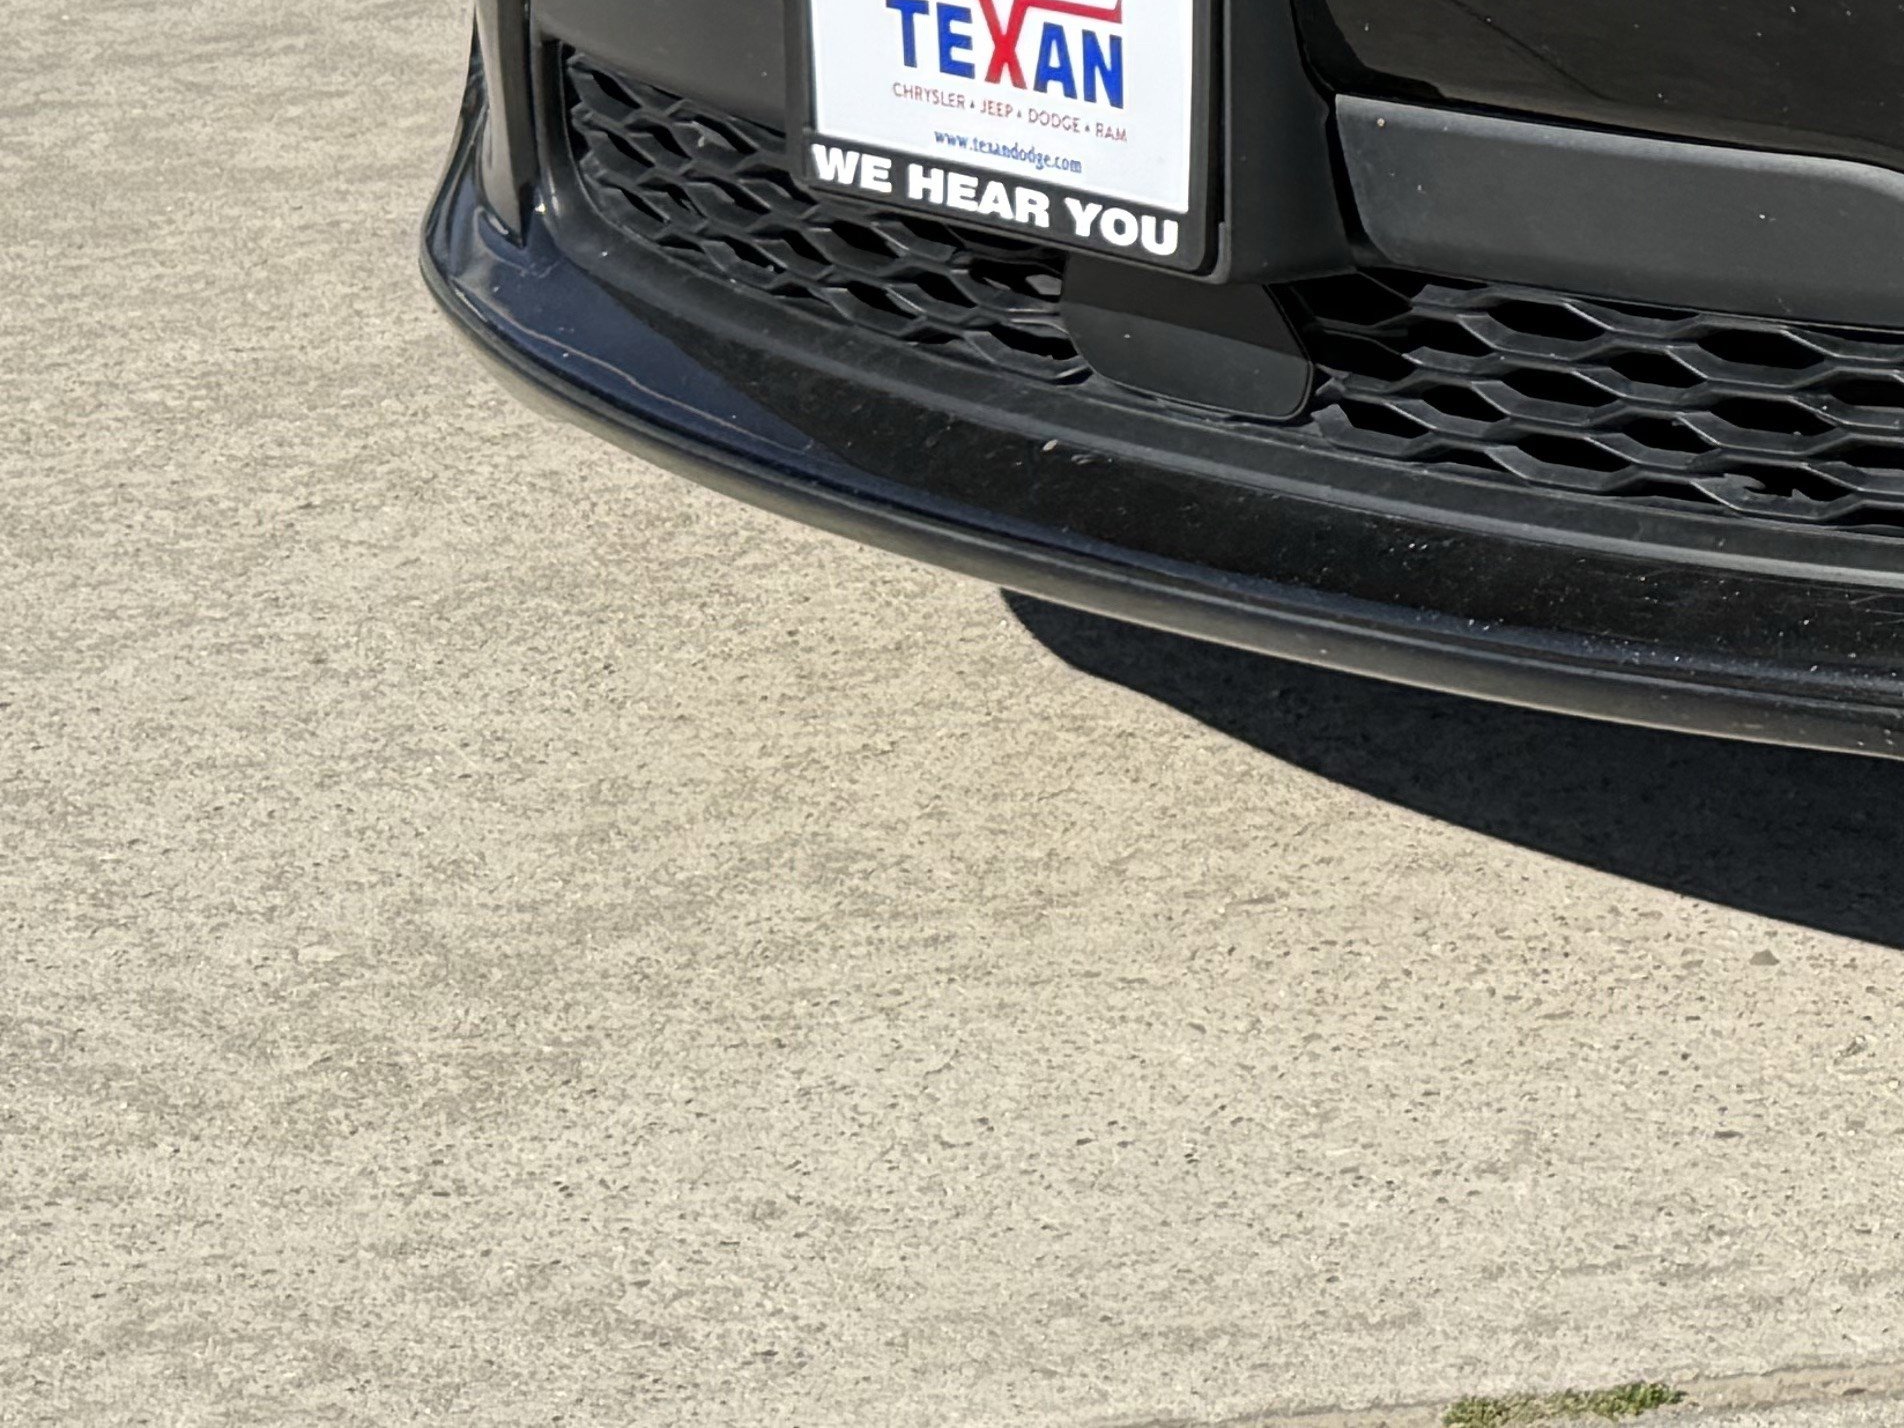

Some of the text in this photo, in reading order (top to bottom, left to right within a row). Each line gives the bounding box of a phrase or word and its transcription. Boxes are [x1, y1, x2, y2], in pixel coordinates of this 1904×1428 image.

[892, 81, 1128, 143] CHRYSLER JEEP DODGE RAM
[934, 130, 1083, 175] www.texandodge.com
[811, 144, 1180, 257] WE HEAR YOU
